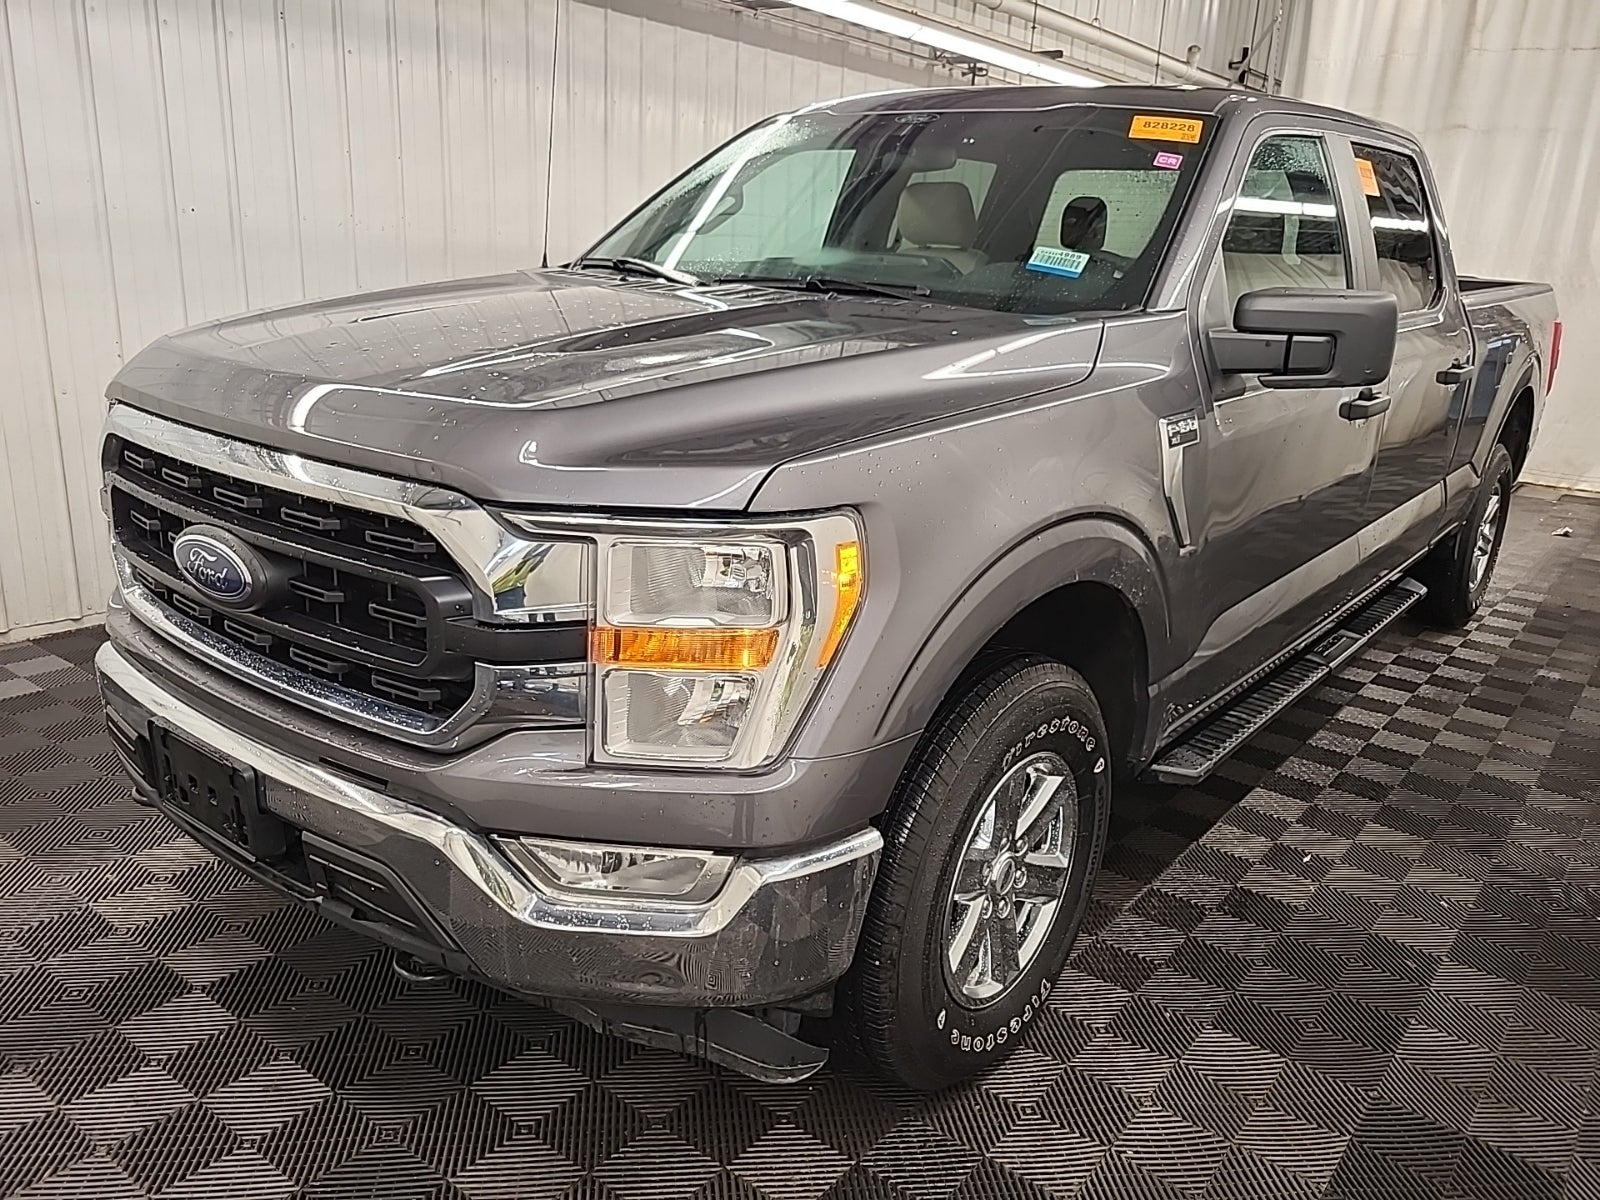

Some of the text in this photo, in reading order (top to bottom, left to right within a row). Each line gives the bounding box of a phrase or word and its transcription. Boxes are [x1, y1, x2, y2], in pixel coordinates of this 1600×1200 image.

[1143, 121, 1195, 132] 828228
[1158, 156, 1178, 166] CR
[187, 547, 228, 590] Ford
[951, 978, 1051, 1052] Firestone
